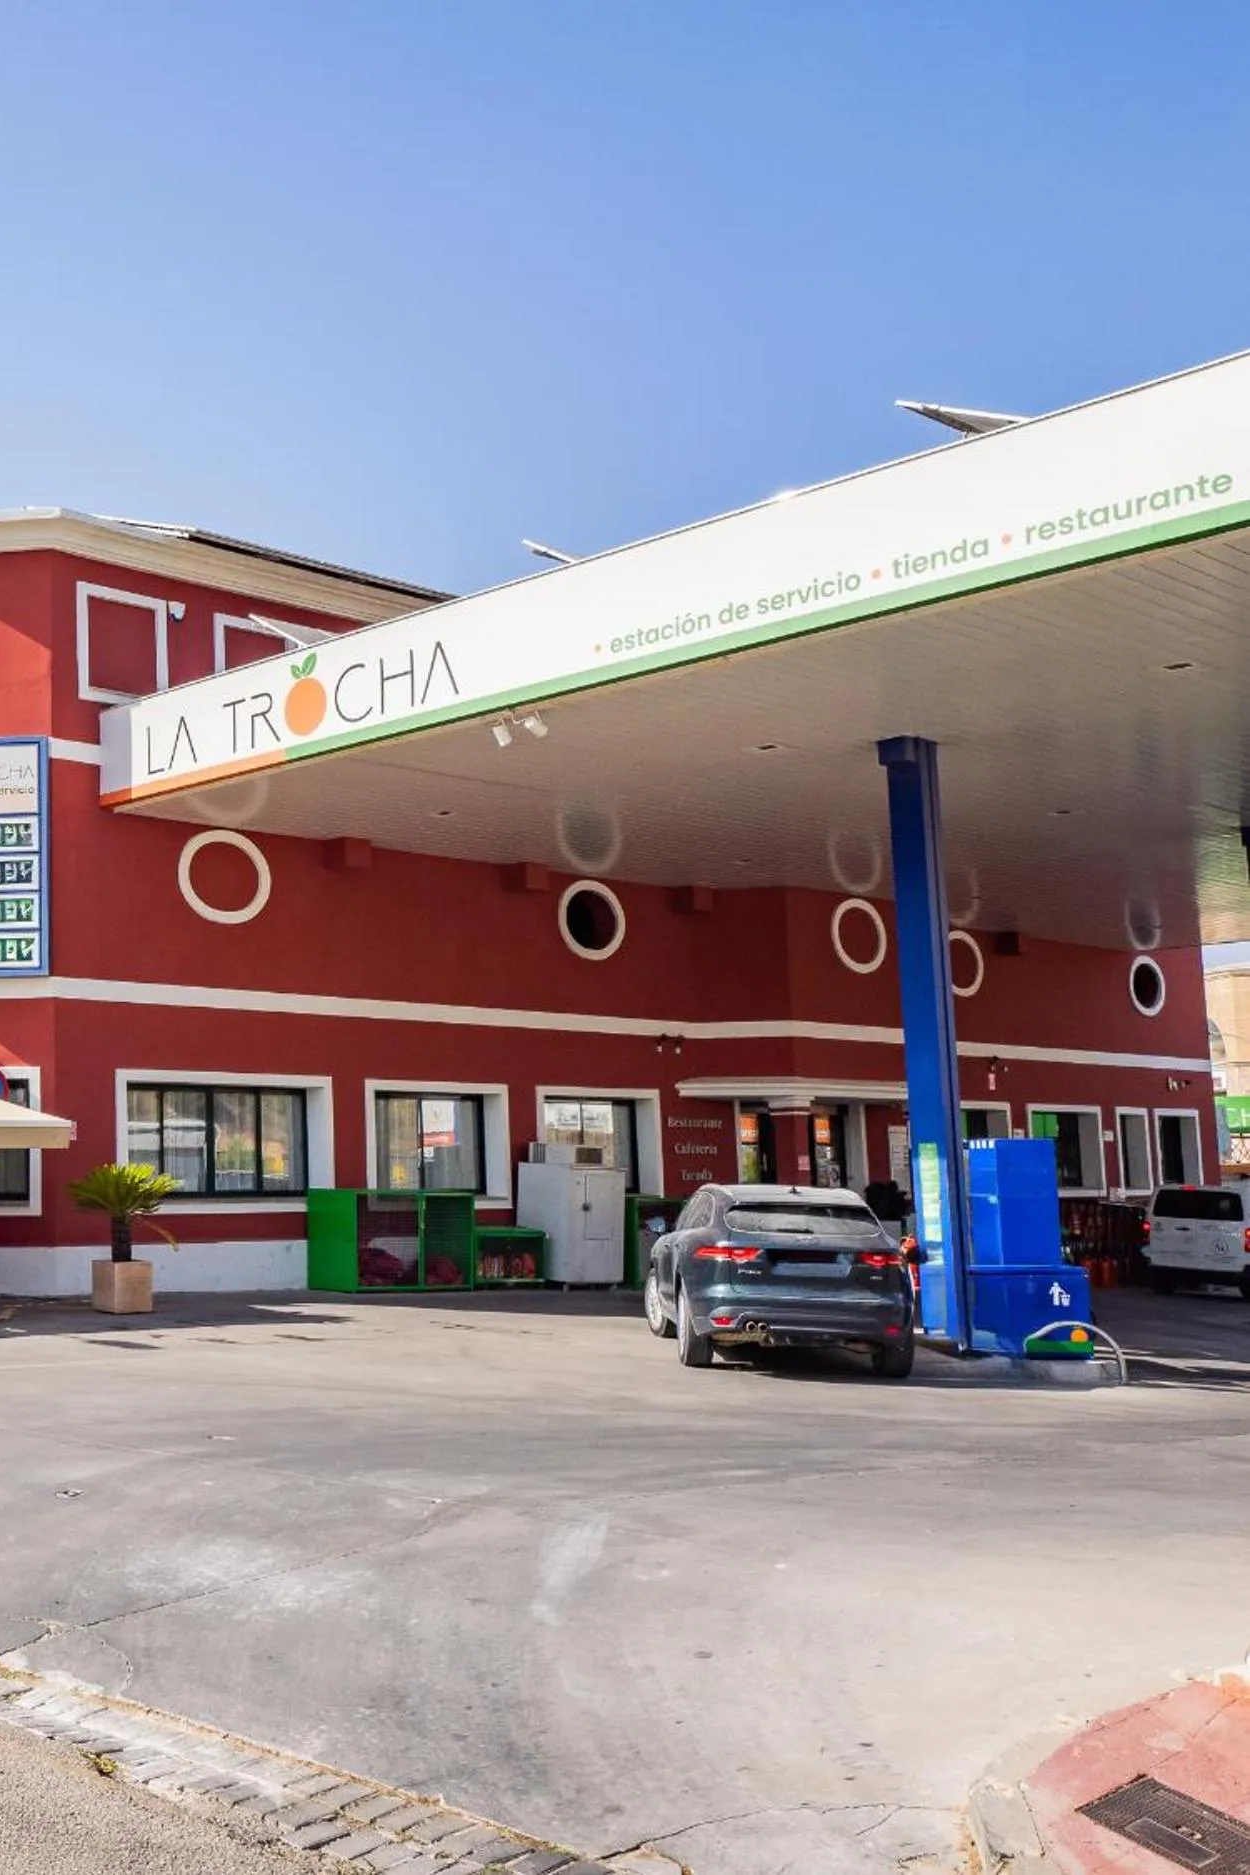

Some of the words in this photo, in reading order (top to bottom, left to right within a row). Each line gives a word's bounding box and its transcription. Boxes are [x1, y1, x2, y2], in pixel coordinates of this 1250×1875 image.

[609, 613, 711, 653] estación
[718, 602, 750, 625] de
[756, 571, 862, 615] servicio
[891, 537, 990, 579] tienda
[1025, 473, 1234, 545] restaurante
[147, 715, 197, 775] LA
[667, 1117, 723, 1129] Restaurante
